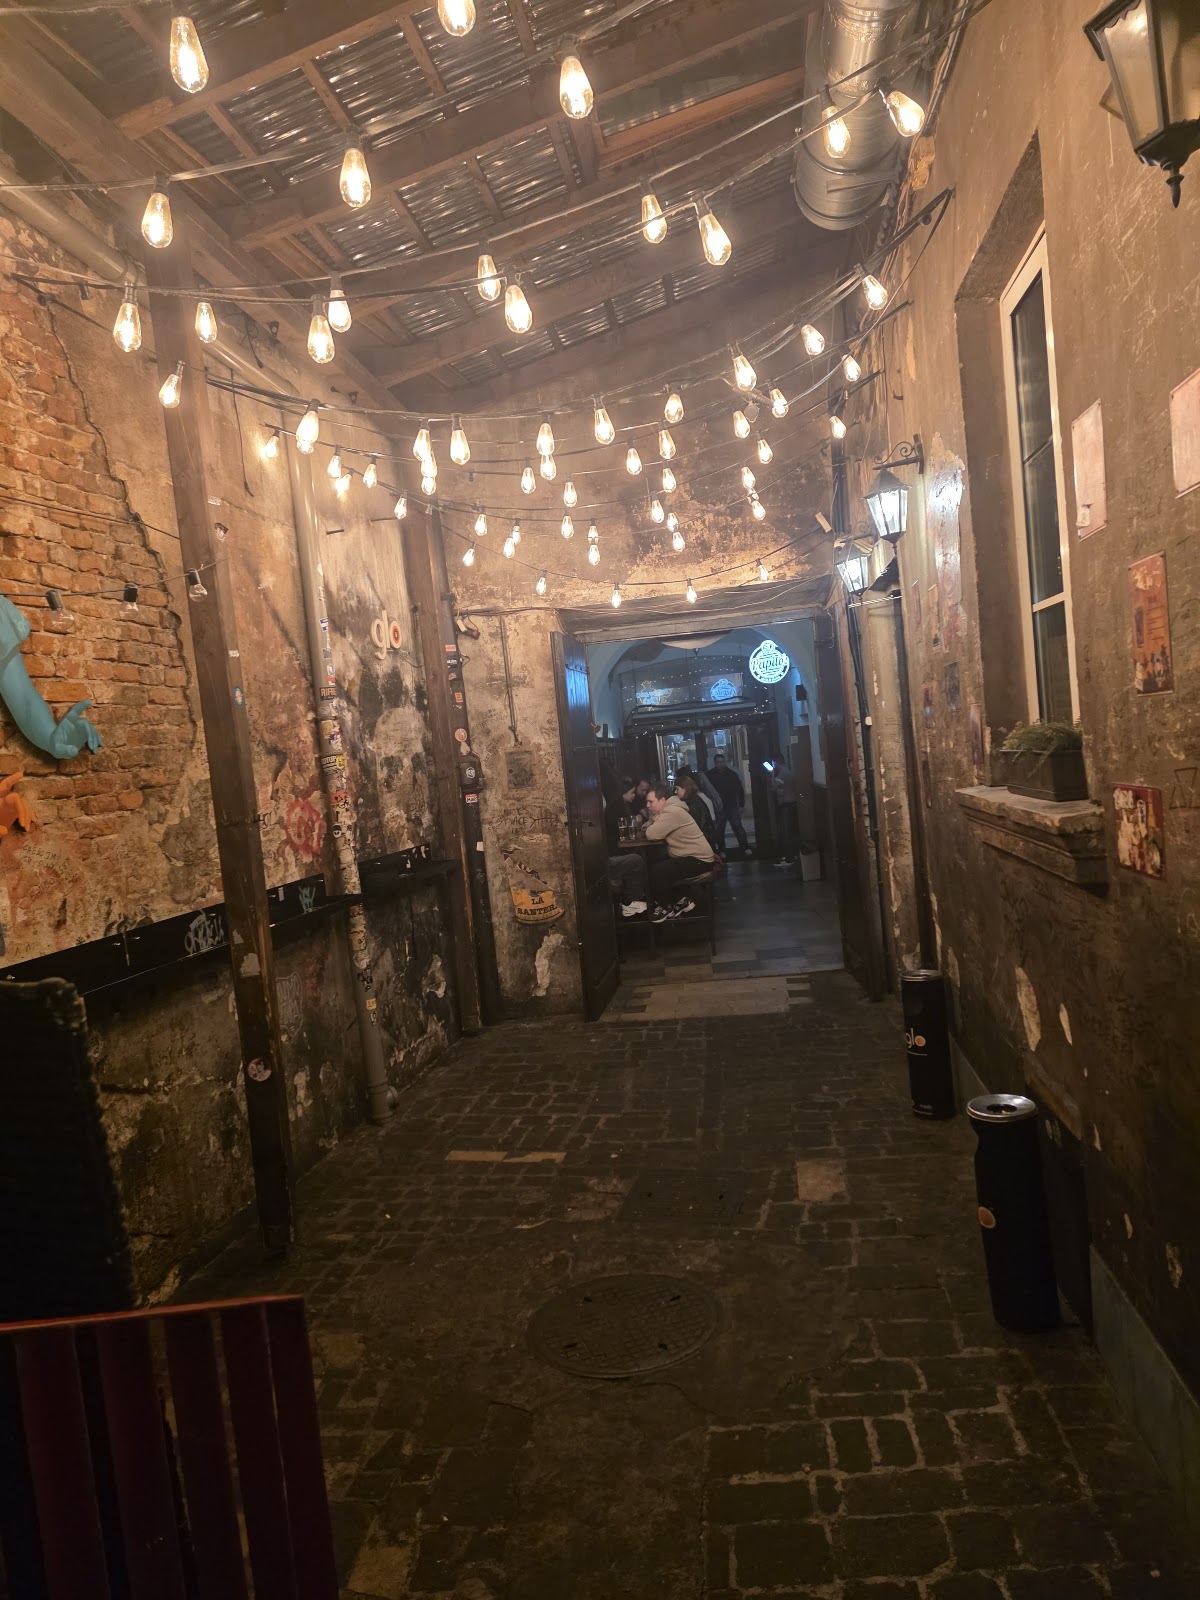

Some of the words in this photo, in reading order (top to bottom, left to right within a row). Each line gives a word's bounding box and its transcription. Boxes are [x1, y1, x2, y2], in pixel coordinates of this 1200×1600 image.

[371, 609, 402, 660] glo
[531, 897, 544, 905] LA
[517, 904, 559, 916] SANTER
